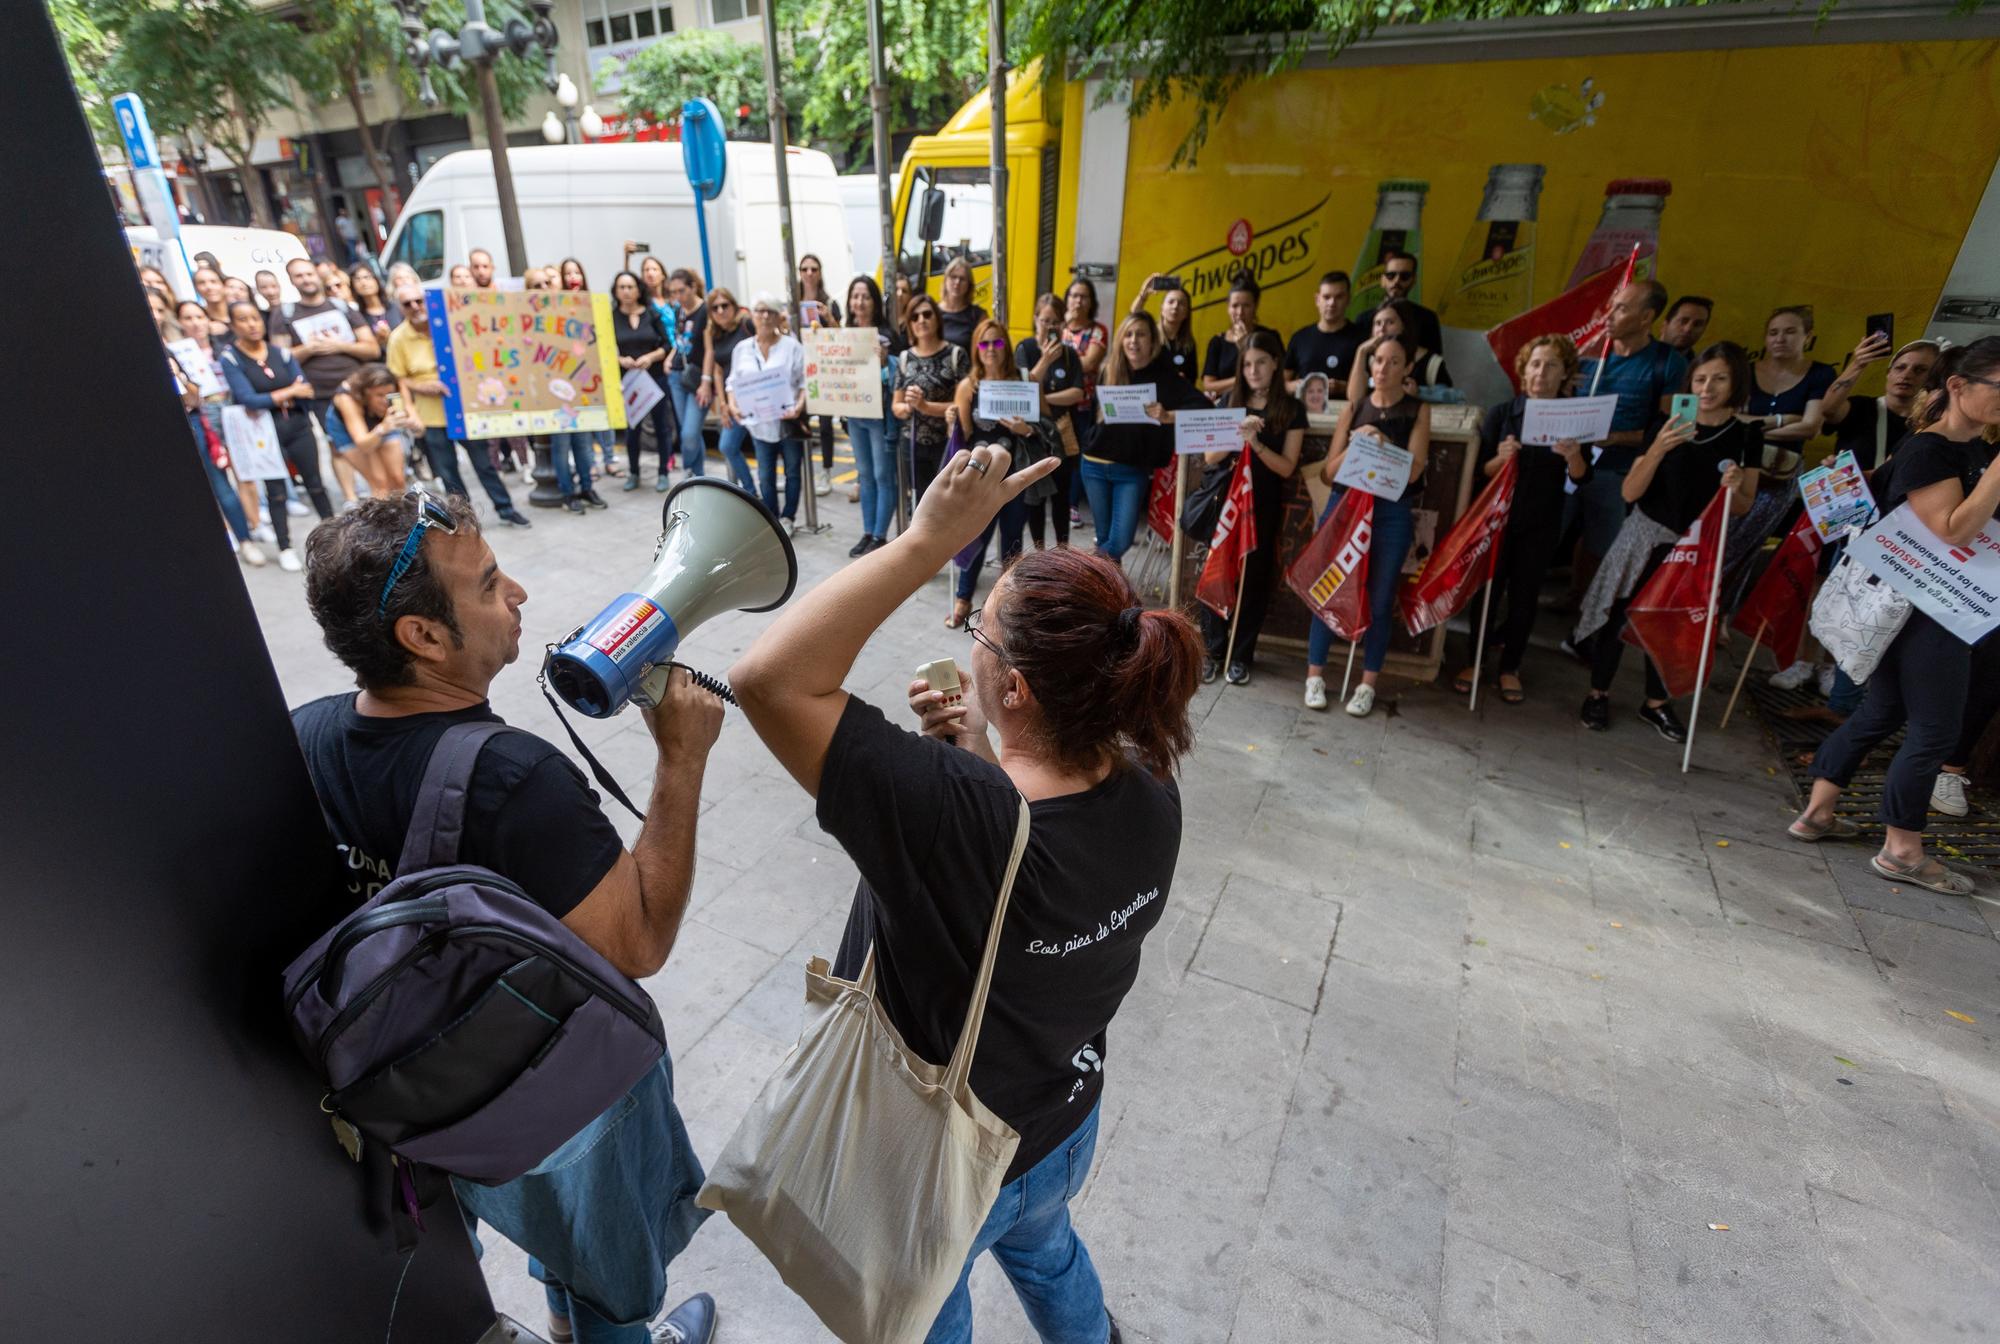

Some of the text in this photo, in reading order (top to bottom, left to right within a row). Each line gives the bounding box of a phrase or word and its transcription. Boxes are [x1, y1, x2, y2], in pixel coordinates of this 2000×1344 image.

[119, 107, 136, 140] P
[1875, 534, 1991, 618] administrativo ABSURDO
[1881, 553, 1915, 580] trabajo
[1895, 530, 1999, 604] para los profesionales
[1914, 578, 1928, 589] de
[1927, 587, 1954, 608] carga
[613, 624, 649, 661] país valencià
[1025, 939, 1061, 955] Los
[1061, 934, 1094, 958] pies
[1095, 922, 1110, 942] de
